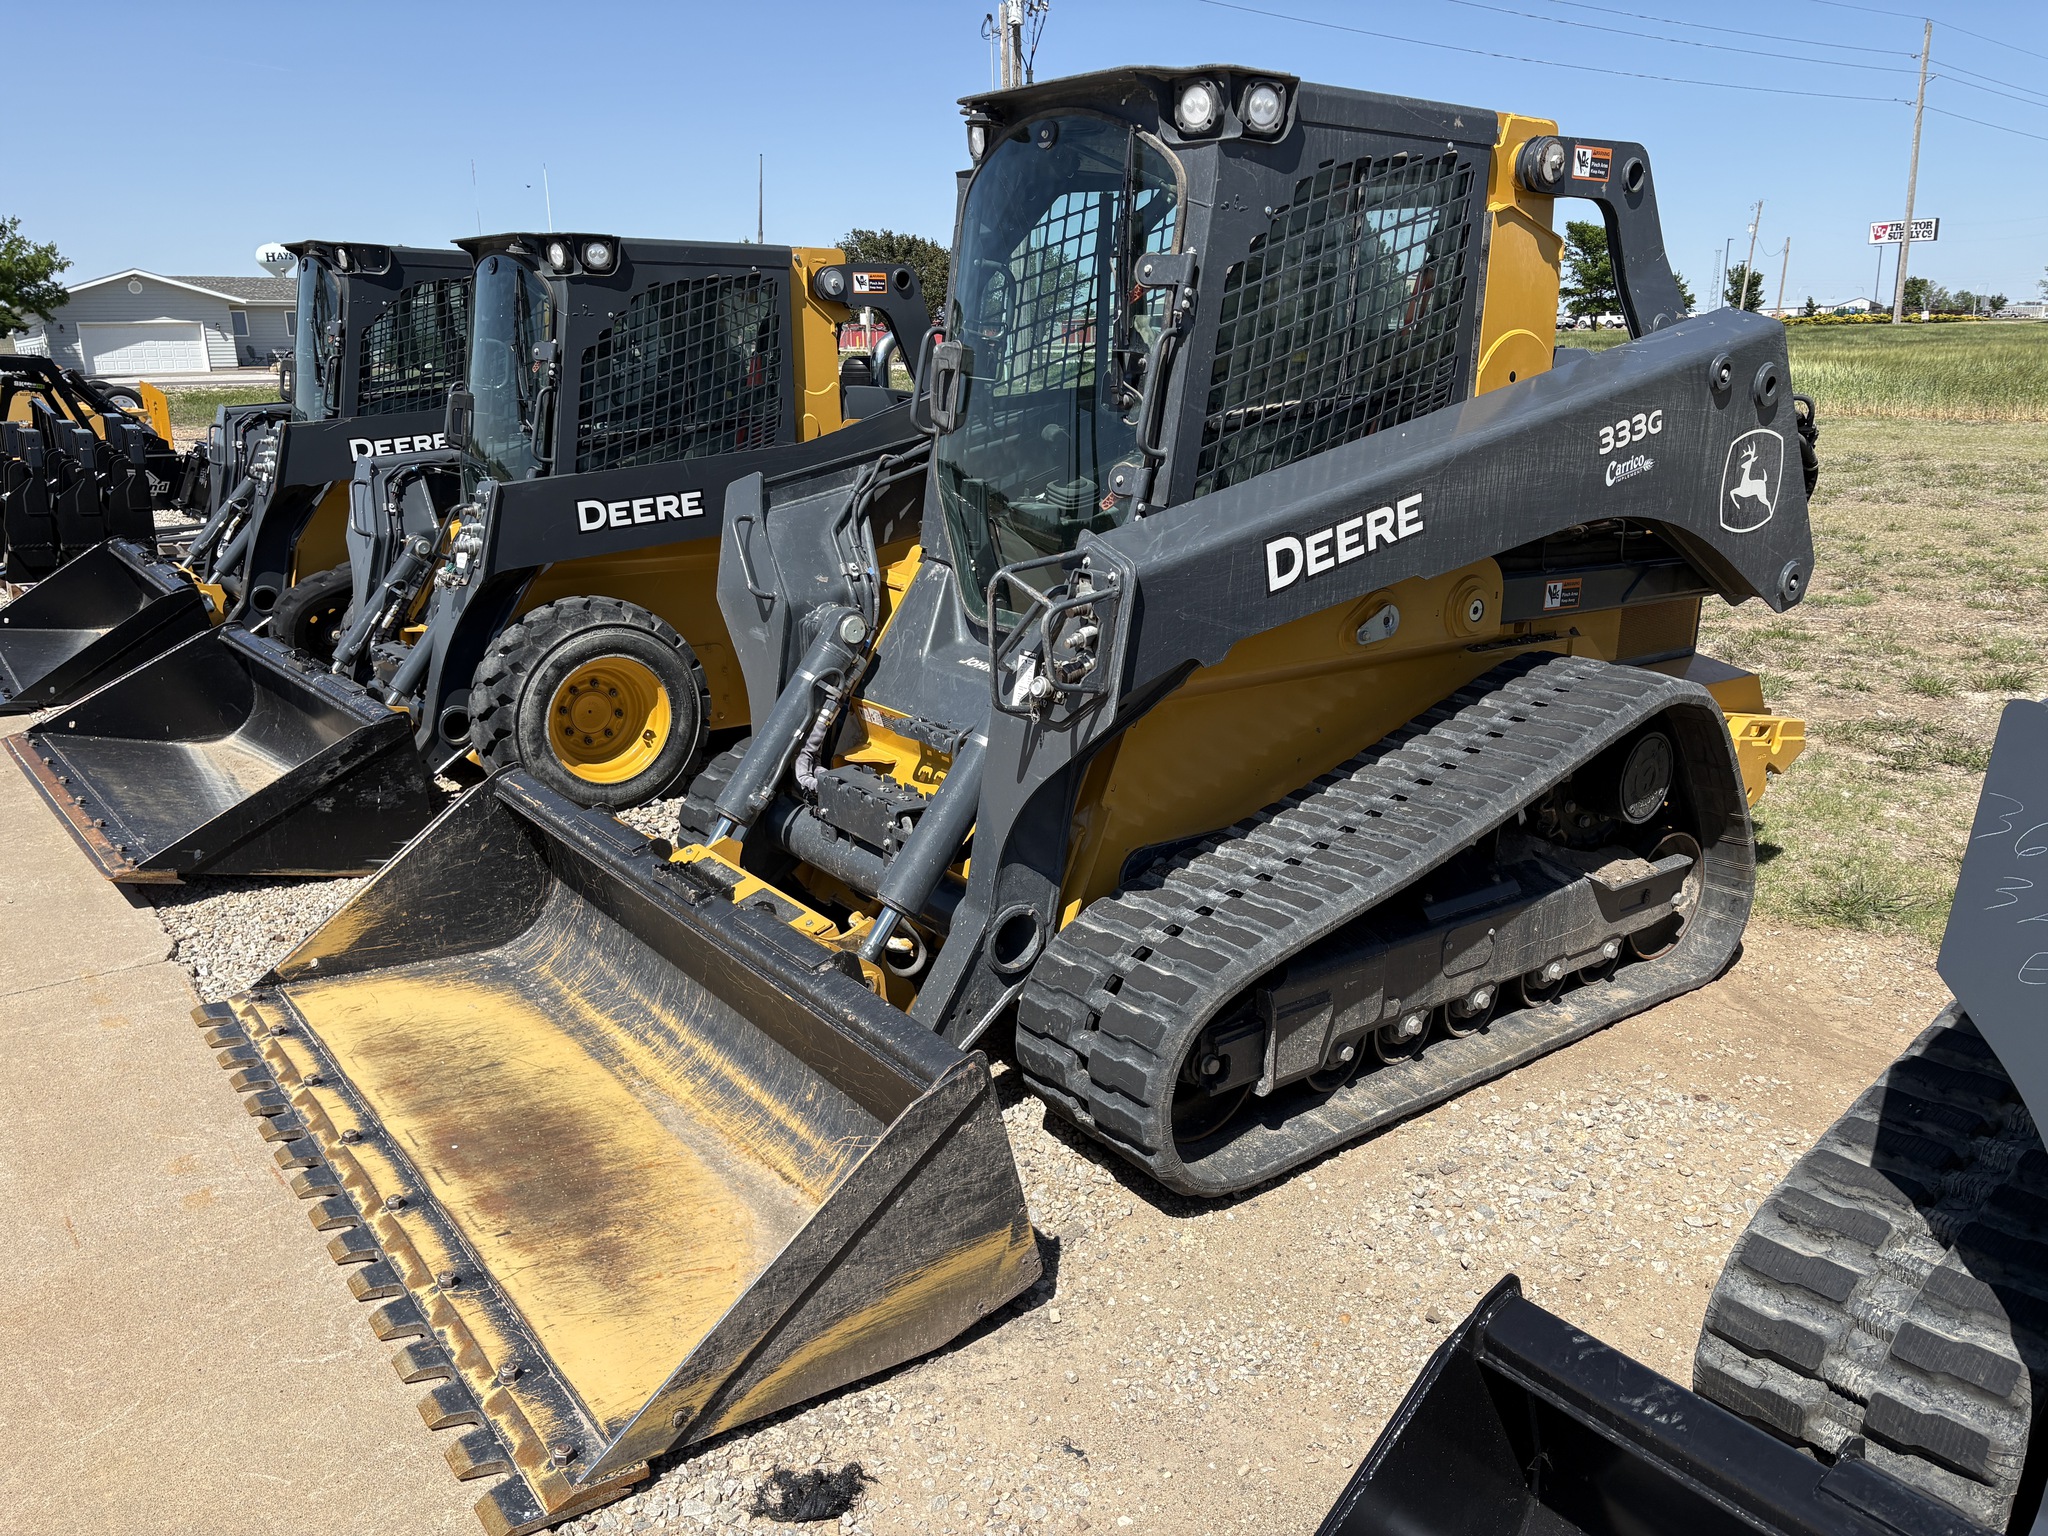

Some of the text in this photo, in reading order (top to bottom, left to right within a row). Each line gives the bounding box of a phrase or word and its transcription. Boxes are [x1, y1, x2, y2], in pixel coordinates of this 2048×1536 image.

[265, 252, 294, 263] HAYS
[1599, 410, 1662, 454] 333G
[1605, 455, 1645, 487] Carrico
[577, 491, 703, 531] DEERE
[1266, 492, 1424, 593] DEERE
